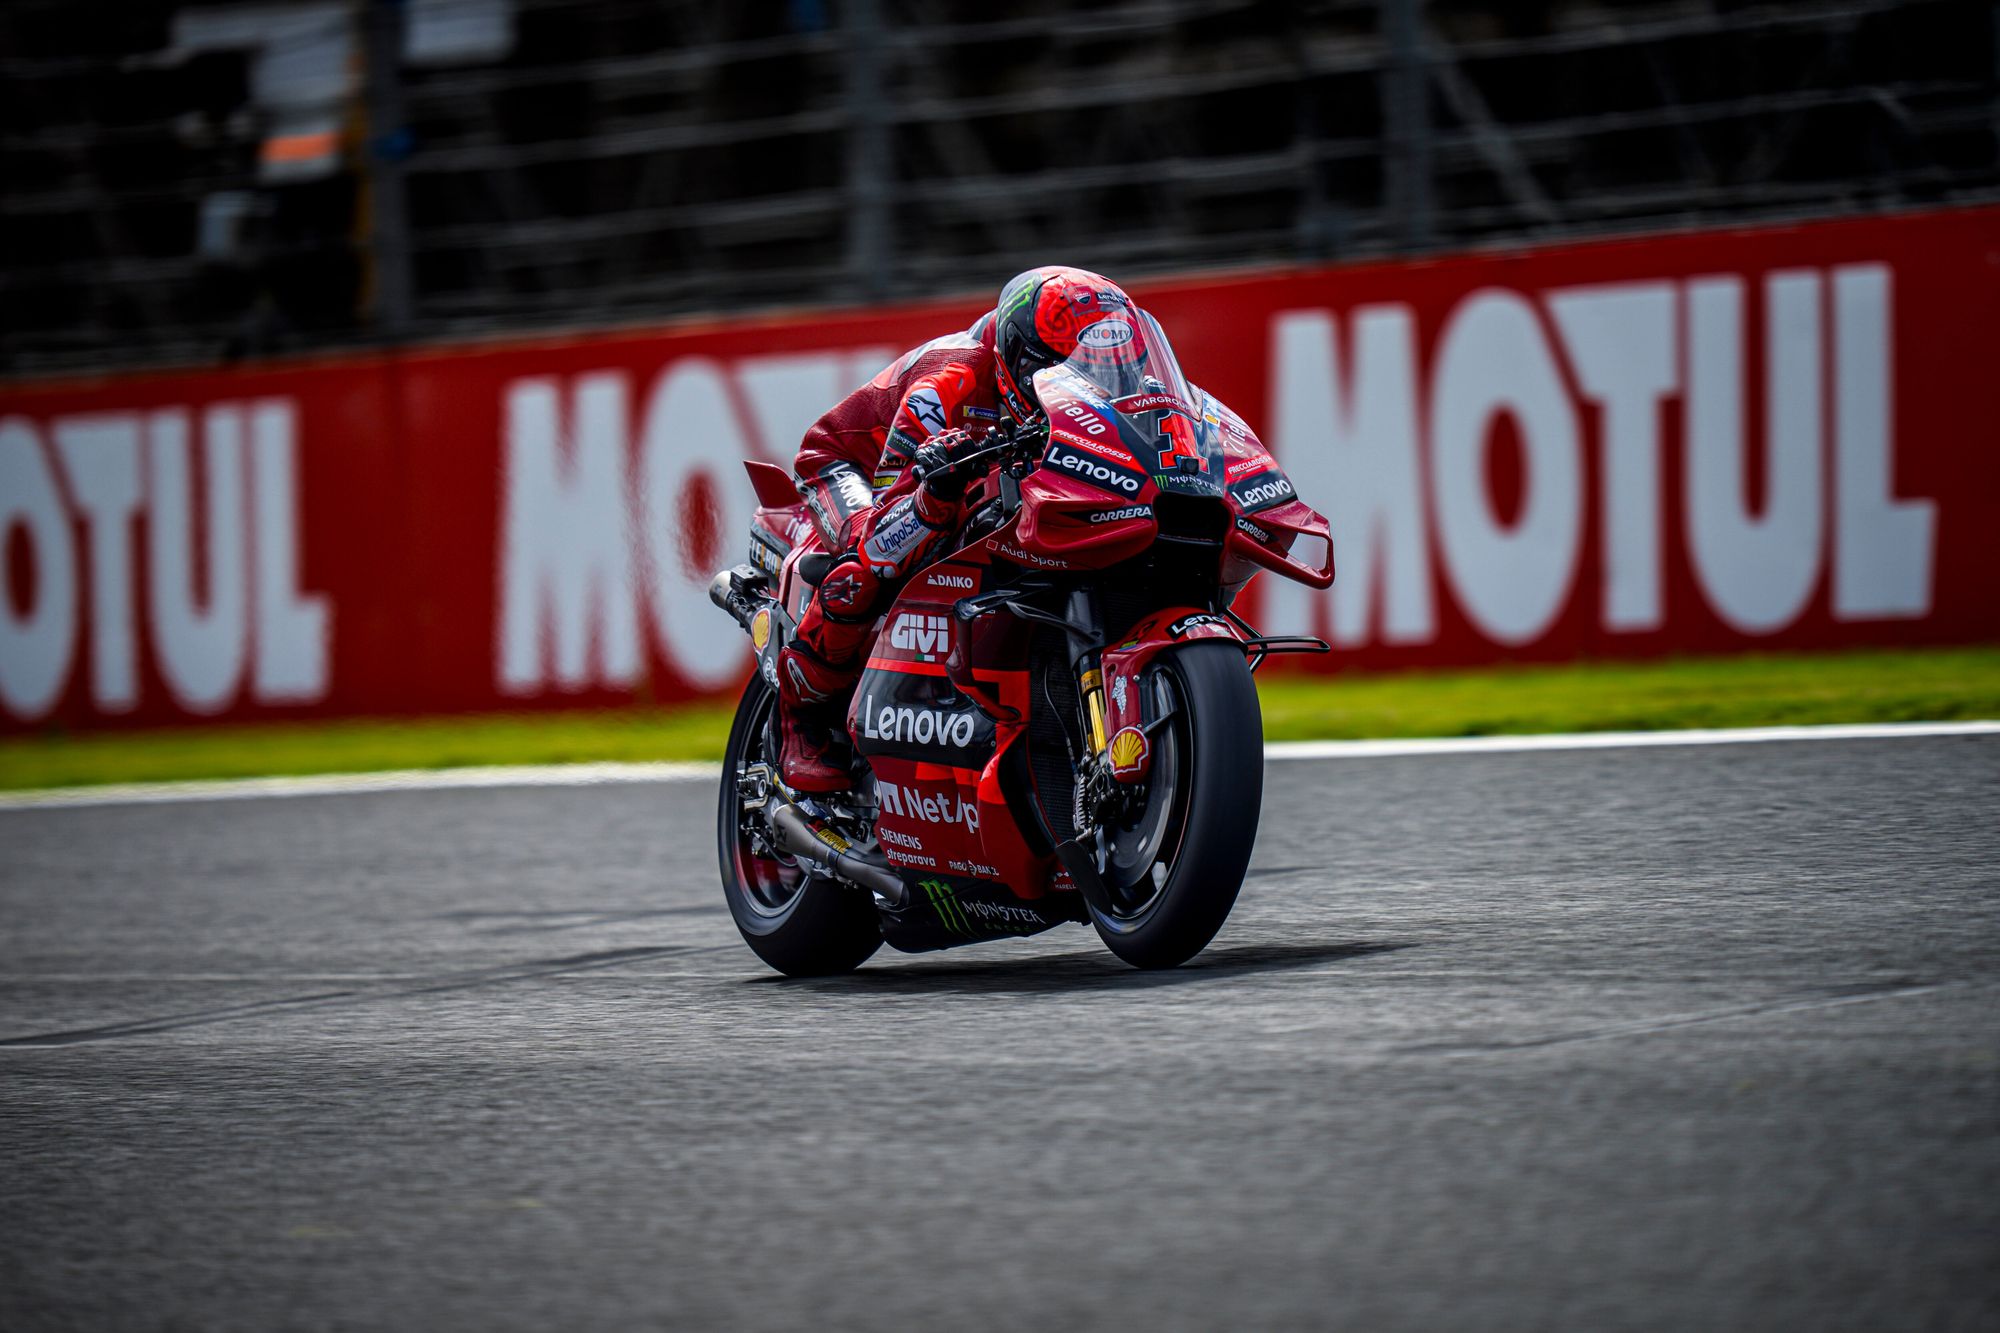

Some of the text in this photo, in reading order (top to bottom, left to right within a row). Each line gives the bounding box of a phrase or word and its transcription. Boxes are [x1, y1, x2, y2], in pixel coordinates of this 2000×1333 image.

[1084, 327, 1130, 342] SUOMY
[1053, 429, 1133, 462] FRECCIAROSSA
[1158, 411, 1211, 475] 1
[1261, 262, 1937, 648] MOTUL
[1047, 447, 1139, 492] Lenovo
[1232, 479, 1292, 507] Lenovo
[1090, 507, 1152, 523] CARRERA
[1237, 519, 1269, 543] CARRERA
[0, 399, 331, 721] OTUL
[1001, 544, 1068, 569] Audi Sport
[938, 576, 974, 589] DAIKO
[891, 613, 949, 654] GIVI
[1171, 615, 1226, 634] Leno
[864, 695, 975, 748] Lenovo
[880, 828, 923, 850] SIEMENS
[887, 849, 936, 867] streparava
[962, 900, 1047, 924] MONSTER
